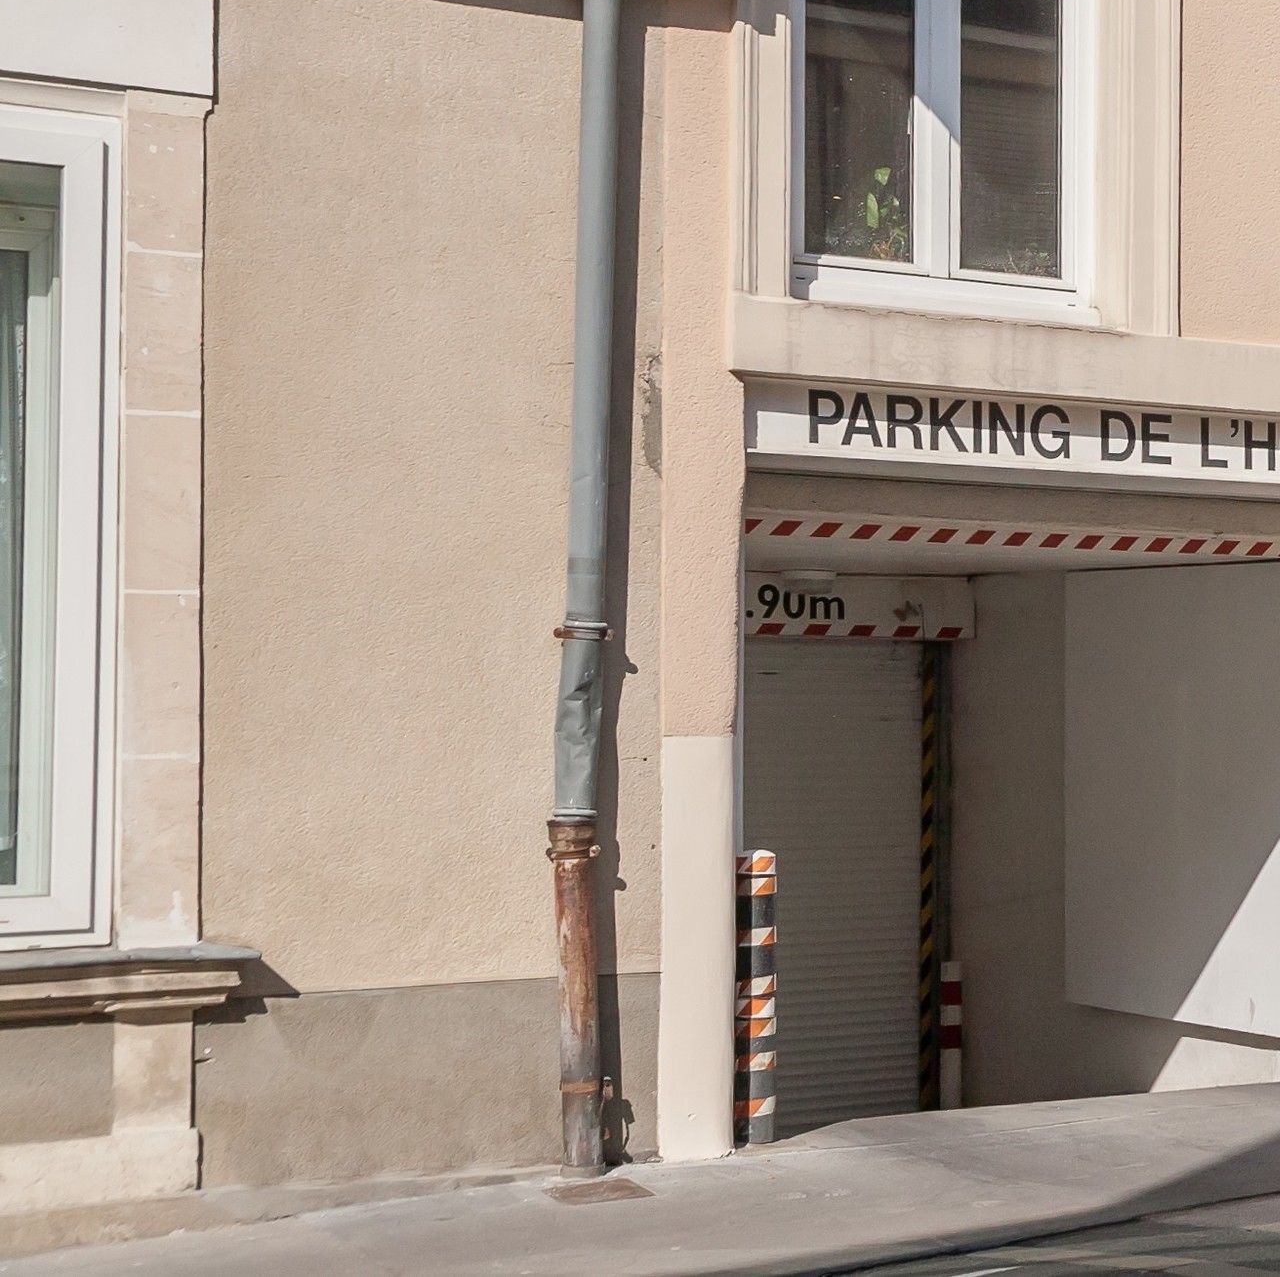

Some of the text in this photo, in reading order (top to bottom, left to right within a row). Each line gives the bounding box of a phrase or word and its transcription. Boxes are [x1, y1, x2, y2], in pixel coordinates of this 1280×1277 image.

[808, 389, 1070, 459] PARKING
[1100, 410, 1172, 464] DE
[746, 583, 845, 619] .90m
